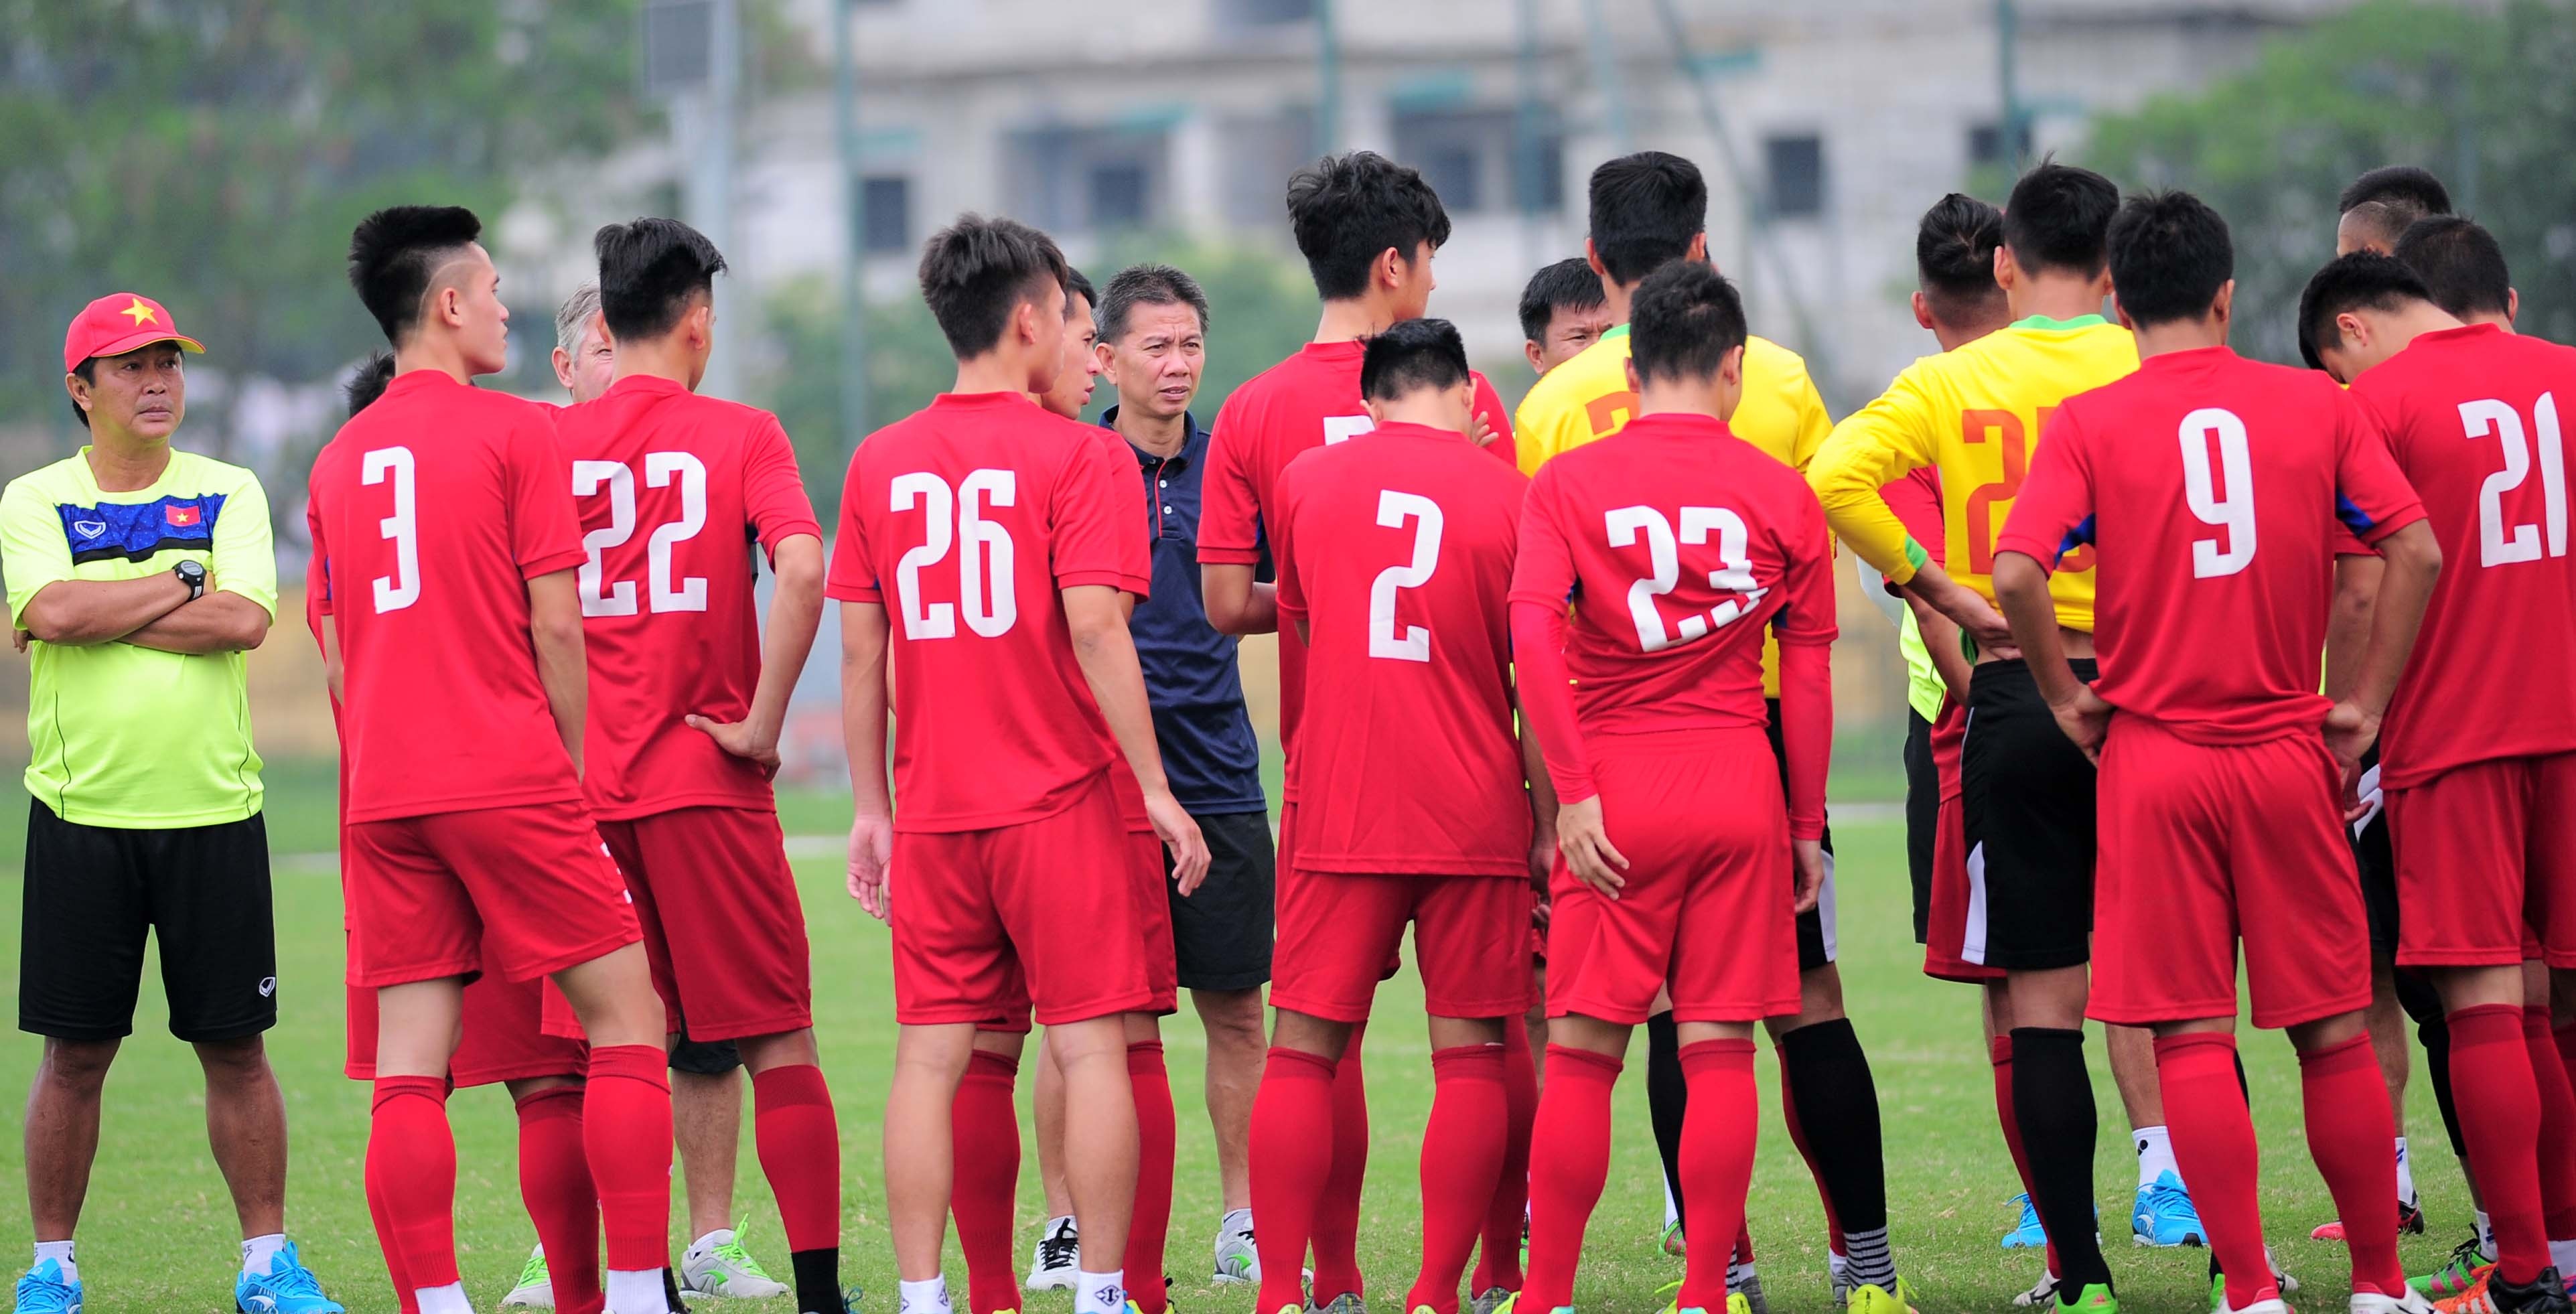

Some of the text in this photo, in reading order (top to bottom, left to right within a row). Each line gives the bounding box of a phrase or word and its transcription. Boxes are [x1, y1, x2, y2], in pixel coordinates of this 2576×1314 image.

[362, 445, 421, 614] 3
[573, 451, 707, 617] 22
[889, 468, 1017, 640] 26
[1962, 407, 2096, 575] 2
[2178, 408, 2257, 579] 9
[2458, 392, 2567, 567] 21
[1368, 489, 1444, 662] 2
[1604, 505, 1769, 652] 23
